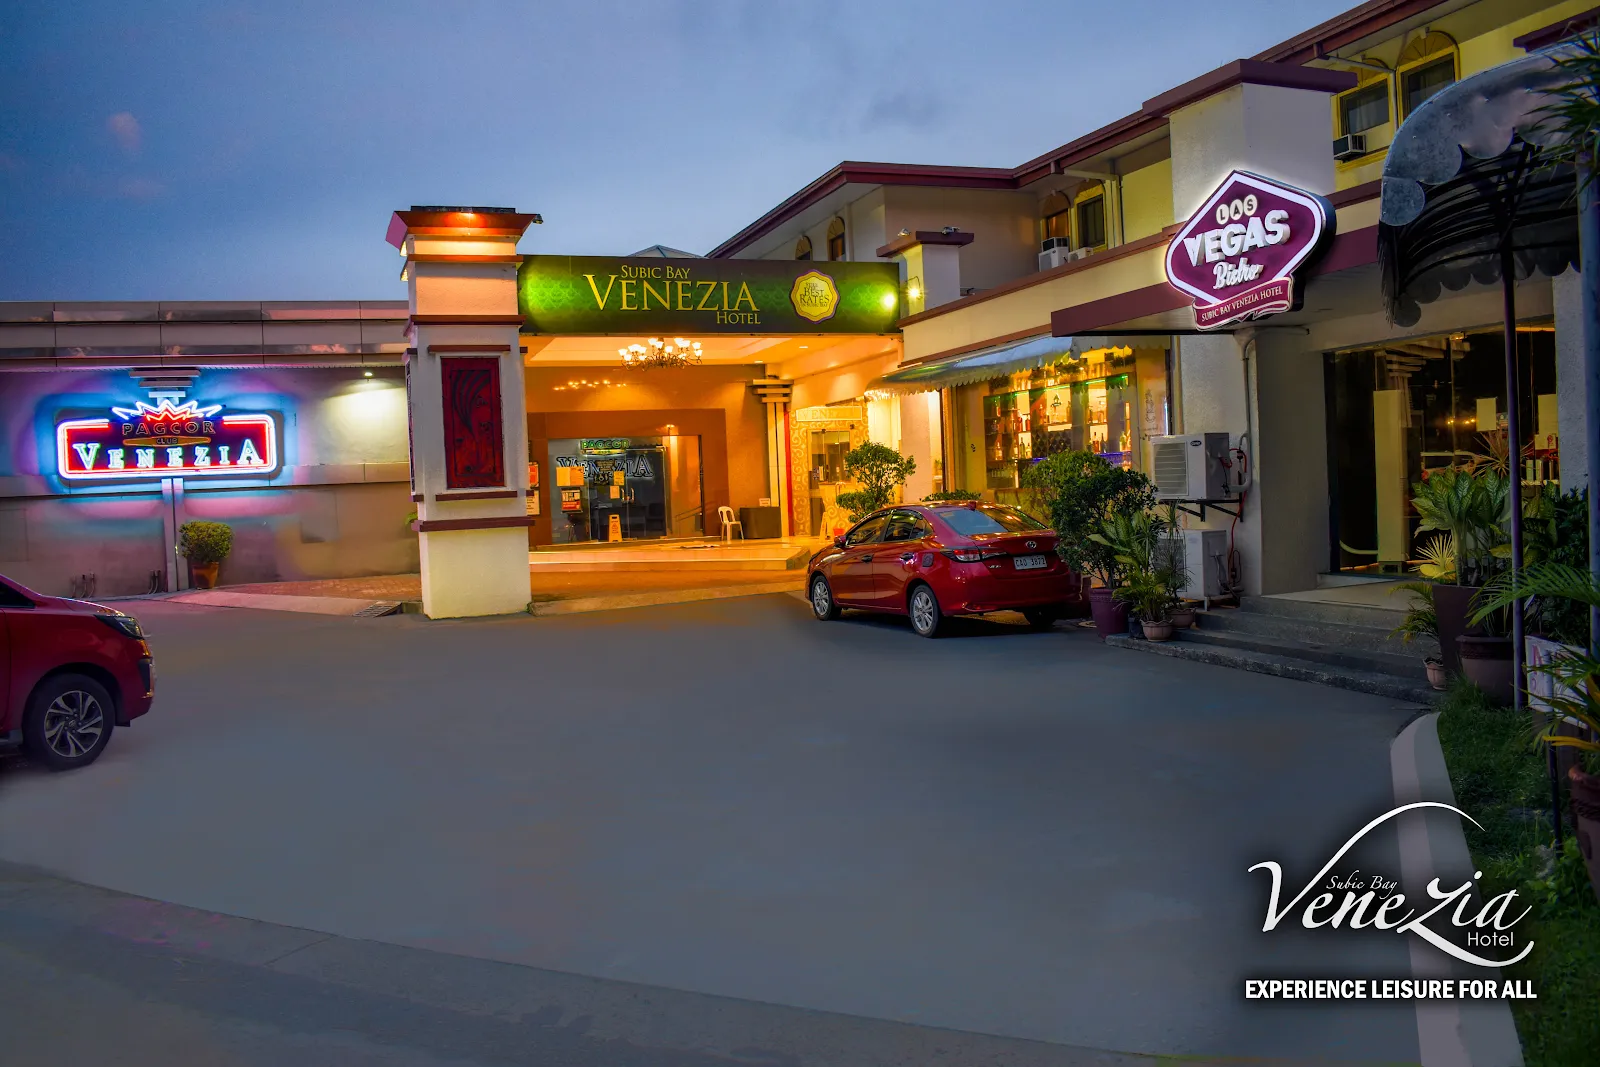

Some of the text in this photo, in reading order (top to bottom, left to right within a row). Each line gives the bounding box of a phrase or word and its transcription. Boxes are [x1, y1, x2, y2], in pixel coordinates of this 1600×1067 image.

[1218, 197, 1256, 222] LAS
[1184, 210, 1291, 267] VEGAS
[620, 265, 690, 279] SUBIC BAY
[583, 274, 760, 311] VENEZIA
[1201, 286, 1283, 322] SUBIC BAY VENEZIA HOTEL
[716, 312, 761, 324] HOTEL
[122, 421, 216, 435] PAGCOR
[73, 439, 263, 470] VENEZIA
